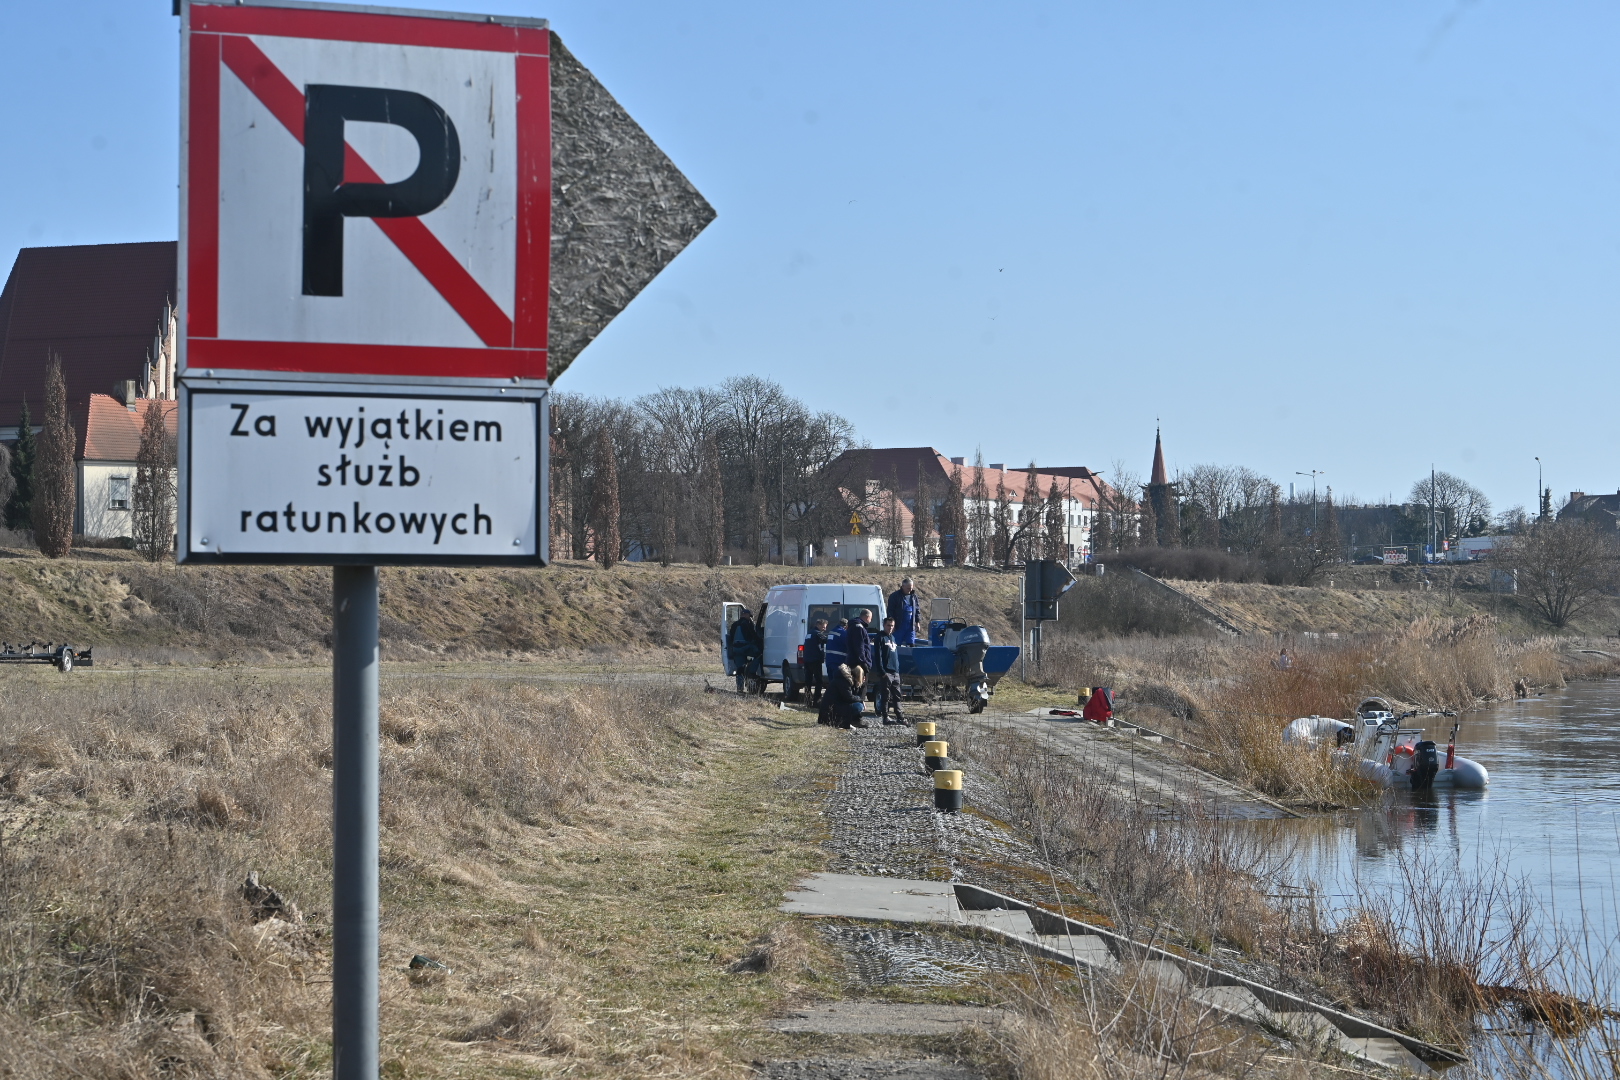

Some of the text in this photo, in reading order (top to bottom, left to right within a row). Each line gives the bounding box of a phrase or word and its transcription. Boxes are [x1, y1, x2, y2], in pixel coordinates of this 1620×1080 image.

[301, 83, 461, 297] P
[229, 403, 503, 450] Za wyjątkiem
[316, 453, 421, 487] służb
[239, 501, 493, 545] ratunkowych
